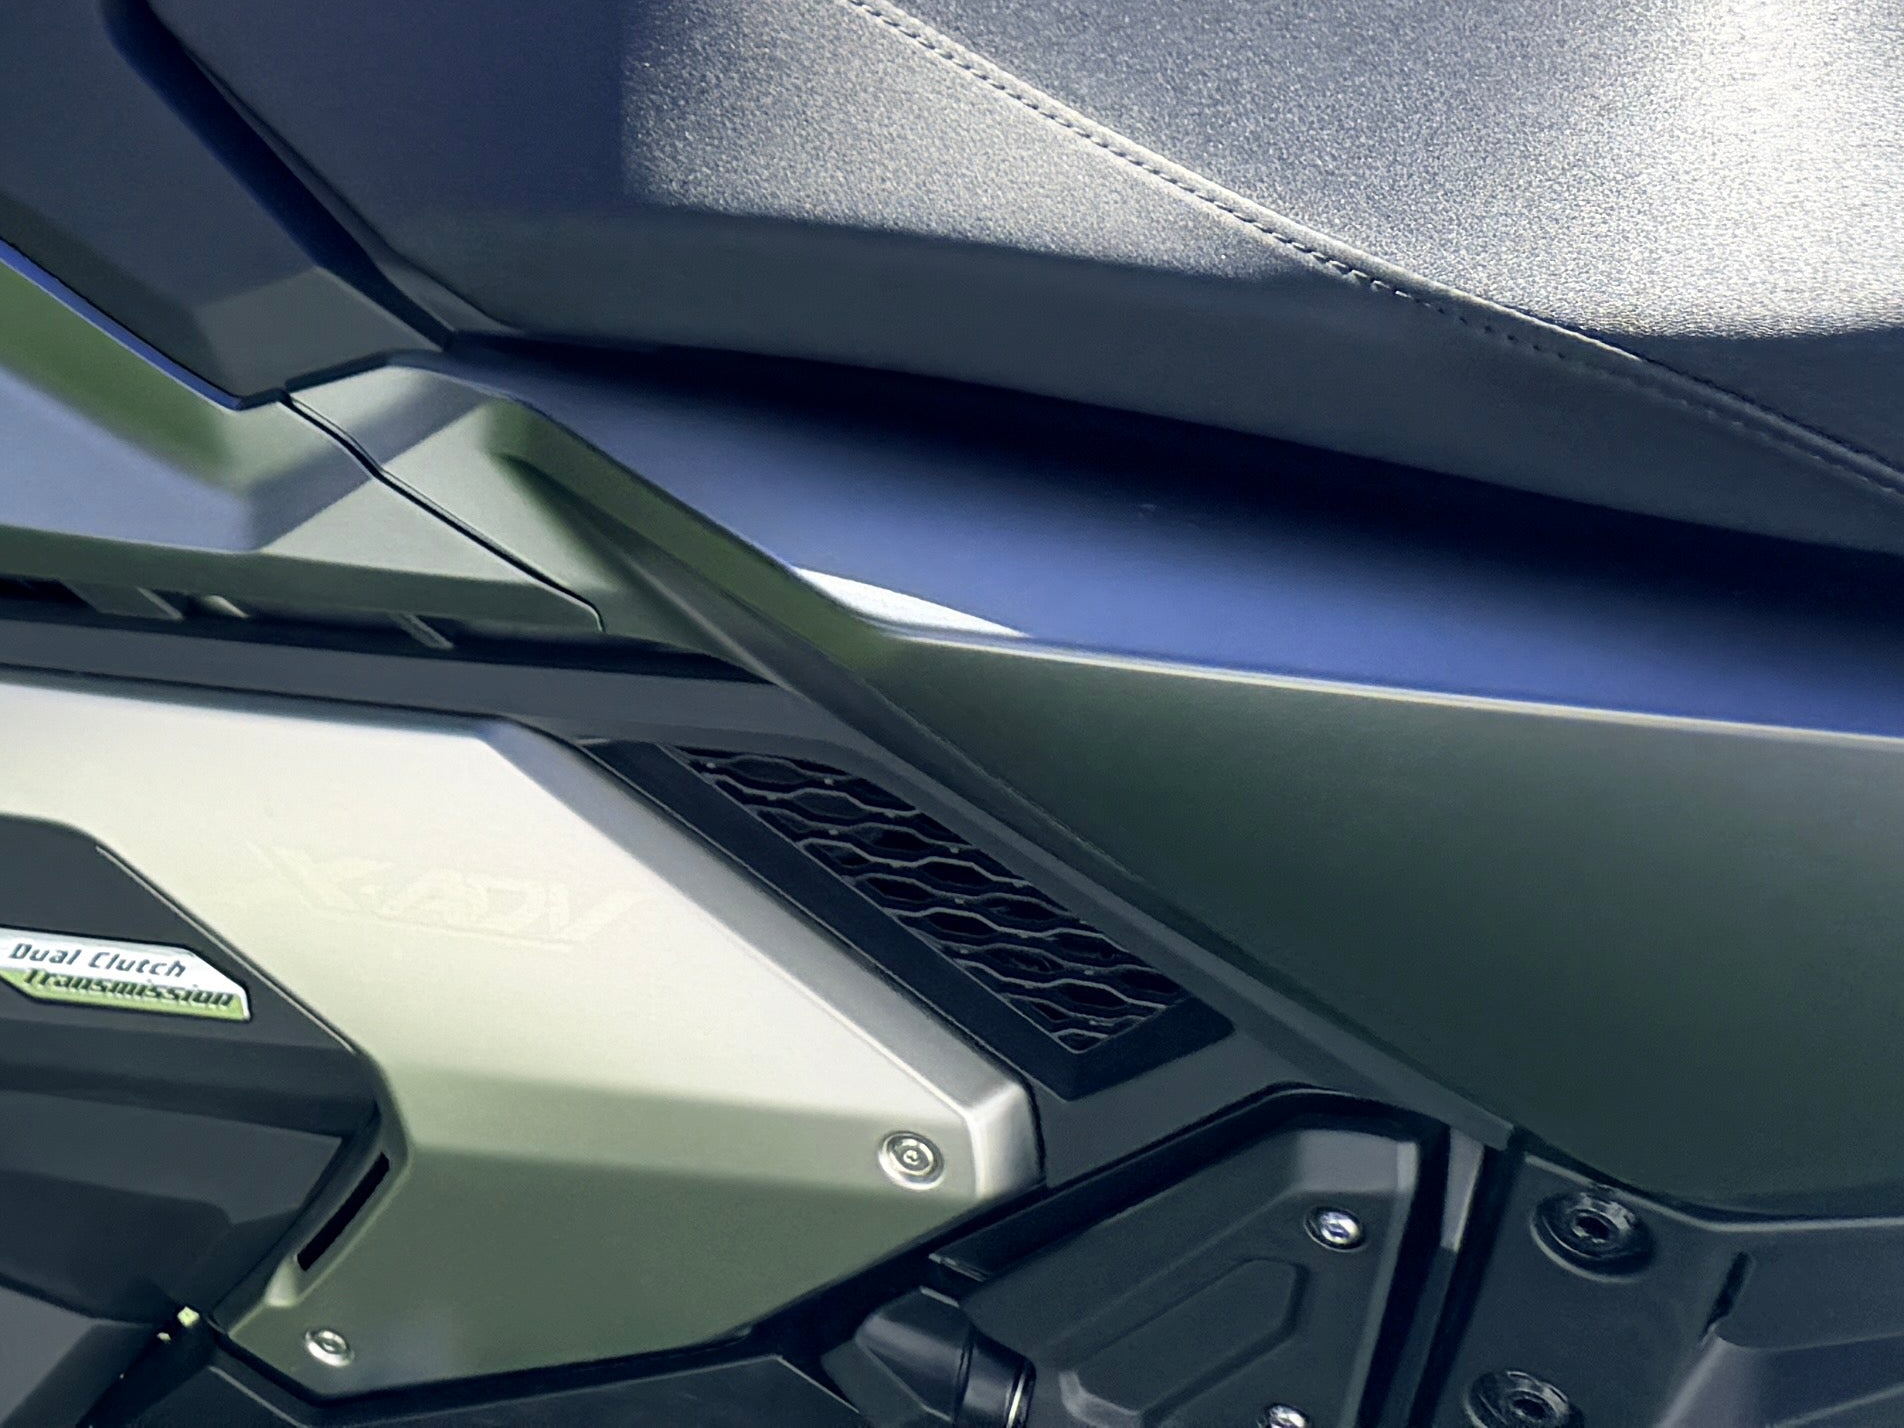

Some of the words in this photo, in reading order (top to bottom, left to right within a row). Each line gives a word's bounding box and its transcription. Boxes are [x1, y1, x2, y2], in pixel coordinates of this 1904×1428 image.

[8, 943, 82, 966] Dual
[89, 951, 187, 977] Clutch
[24, 967, 233, 1007] Transmission
